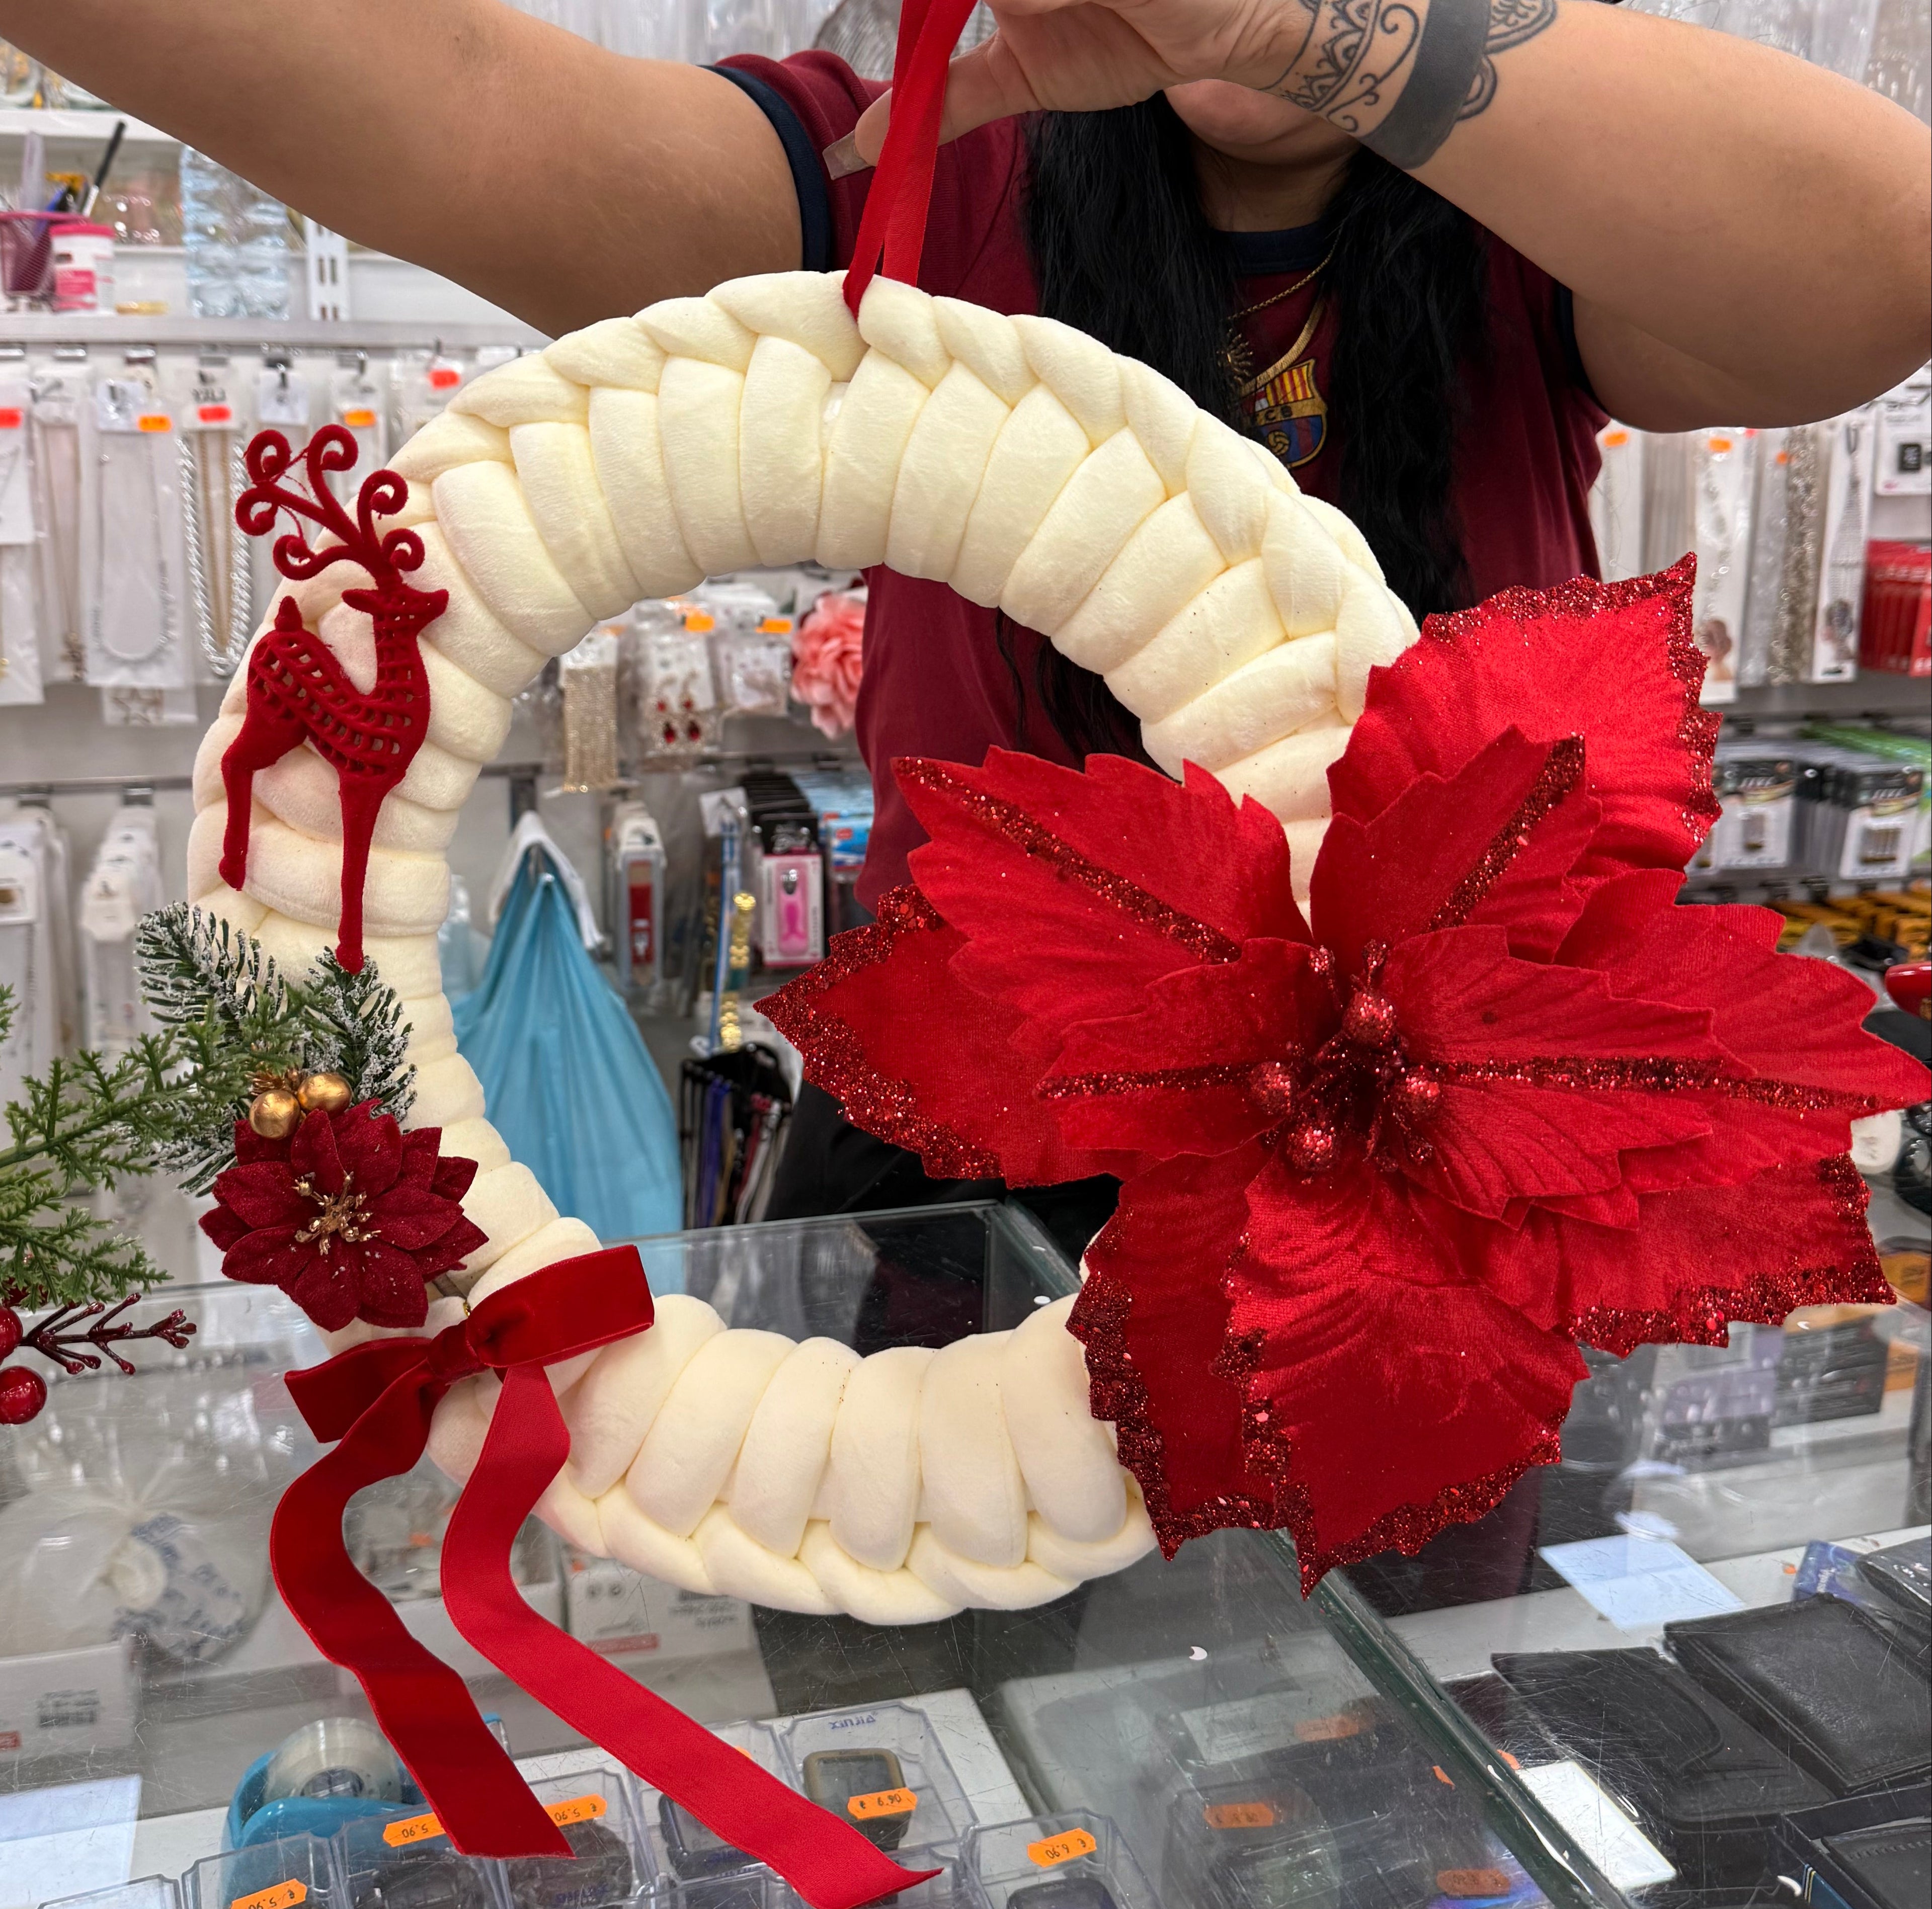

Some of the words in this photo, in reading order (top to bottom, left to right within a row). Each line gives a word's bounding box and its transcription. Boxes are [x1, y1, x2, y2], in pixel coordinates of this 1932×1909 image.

[877, 1793, 902, 1806] 6.90
[554, 1808, 581, 1821] 5.90
[401, 1823, 429, 1838] 5.90
[1045, 1843, 1070, 1859] 6.90
